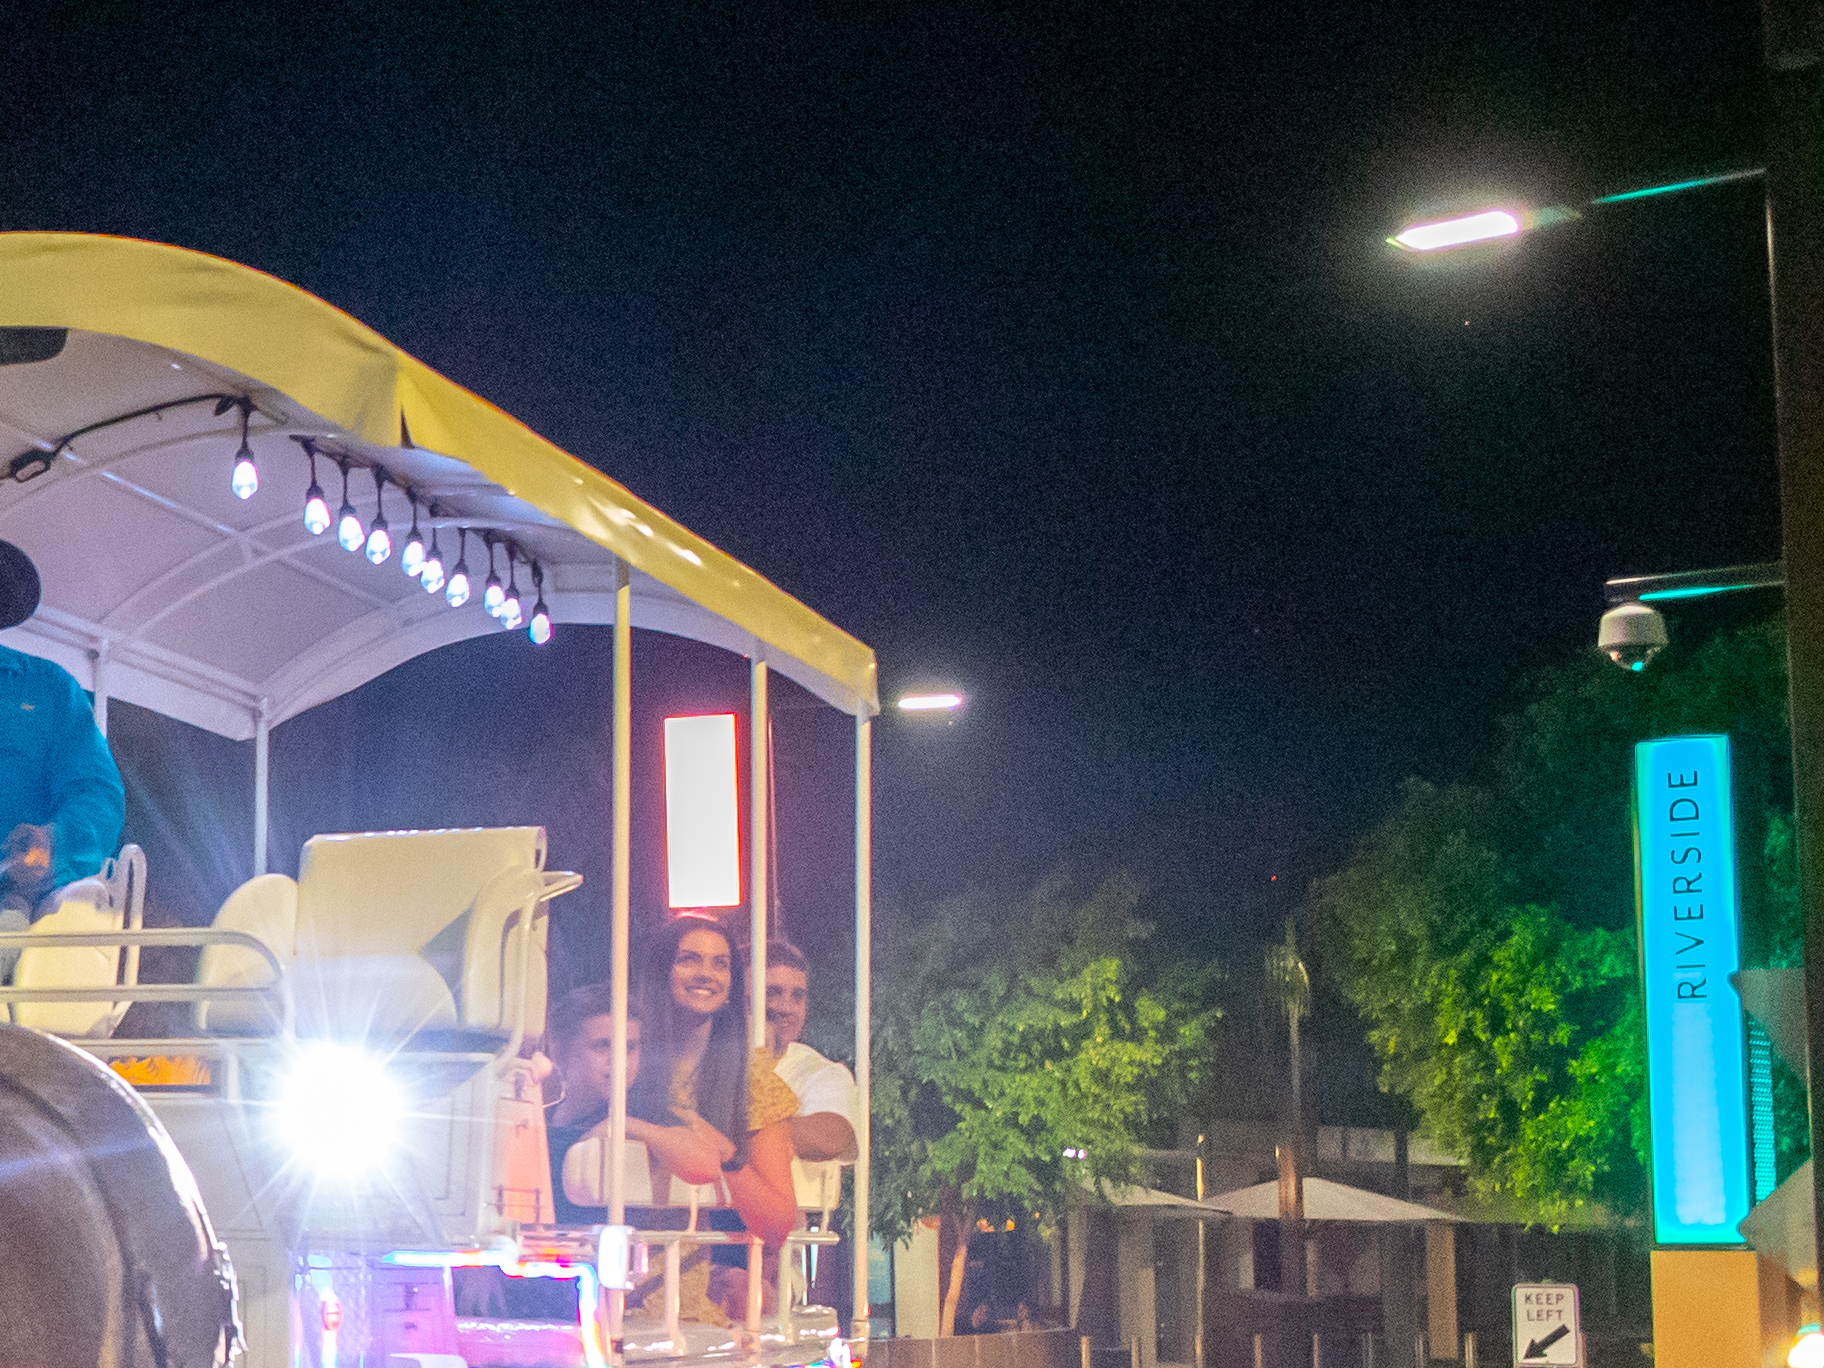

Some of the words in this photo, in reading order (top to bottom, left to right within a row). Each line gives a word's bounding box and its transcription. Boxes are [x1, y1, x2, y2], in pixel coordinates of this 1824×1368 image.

[1667, 770, 1708, 1000] RIVERSIDE
[1524, 1293, 1564, 1305] KEEP
[1526, 1309, 1563, 1321] LEFT
